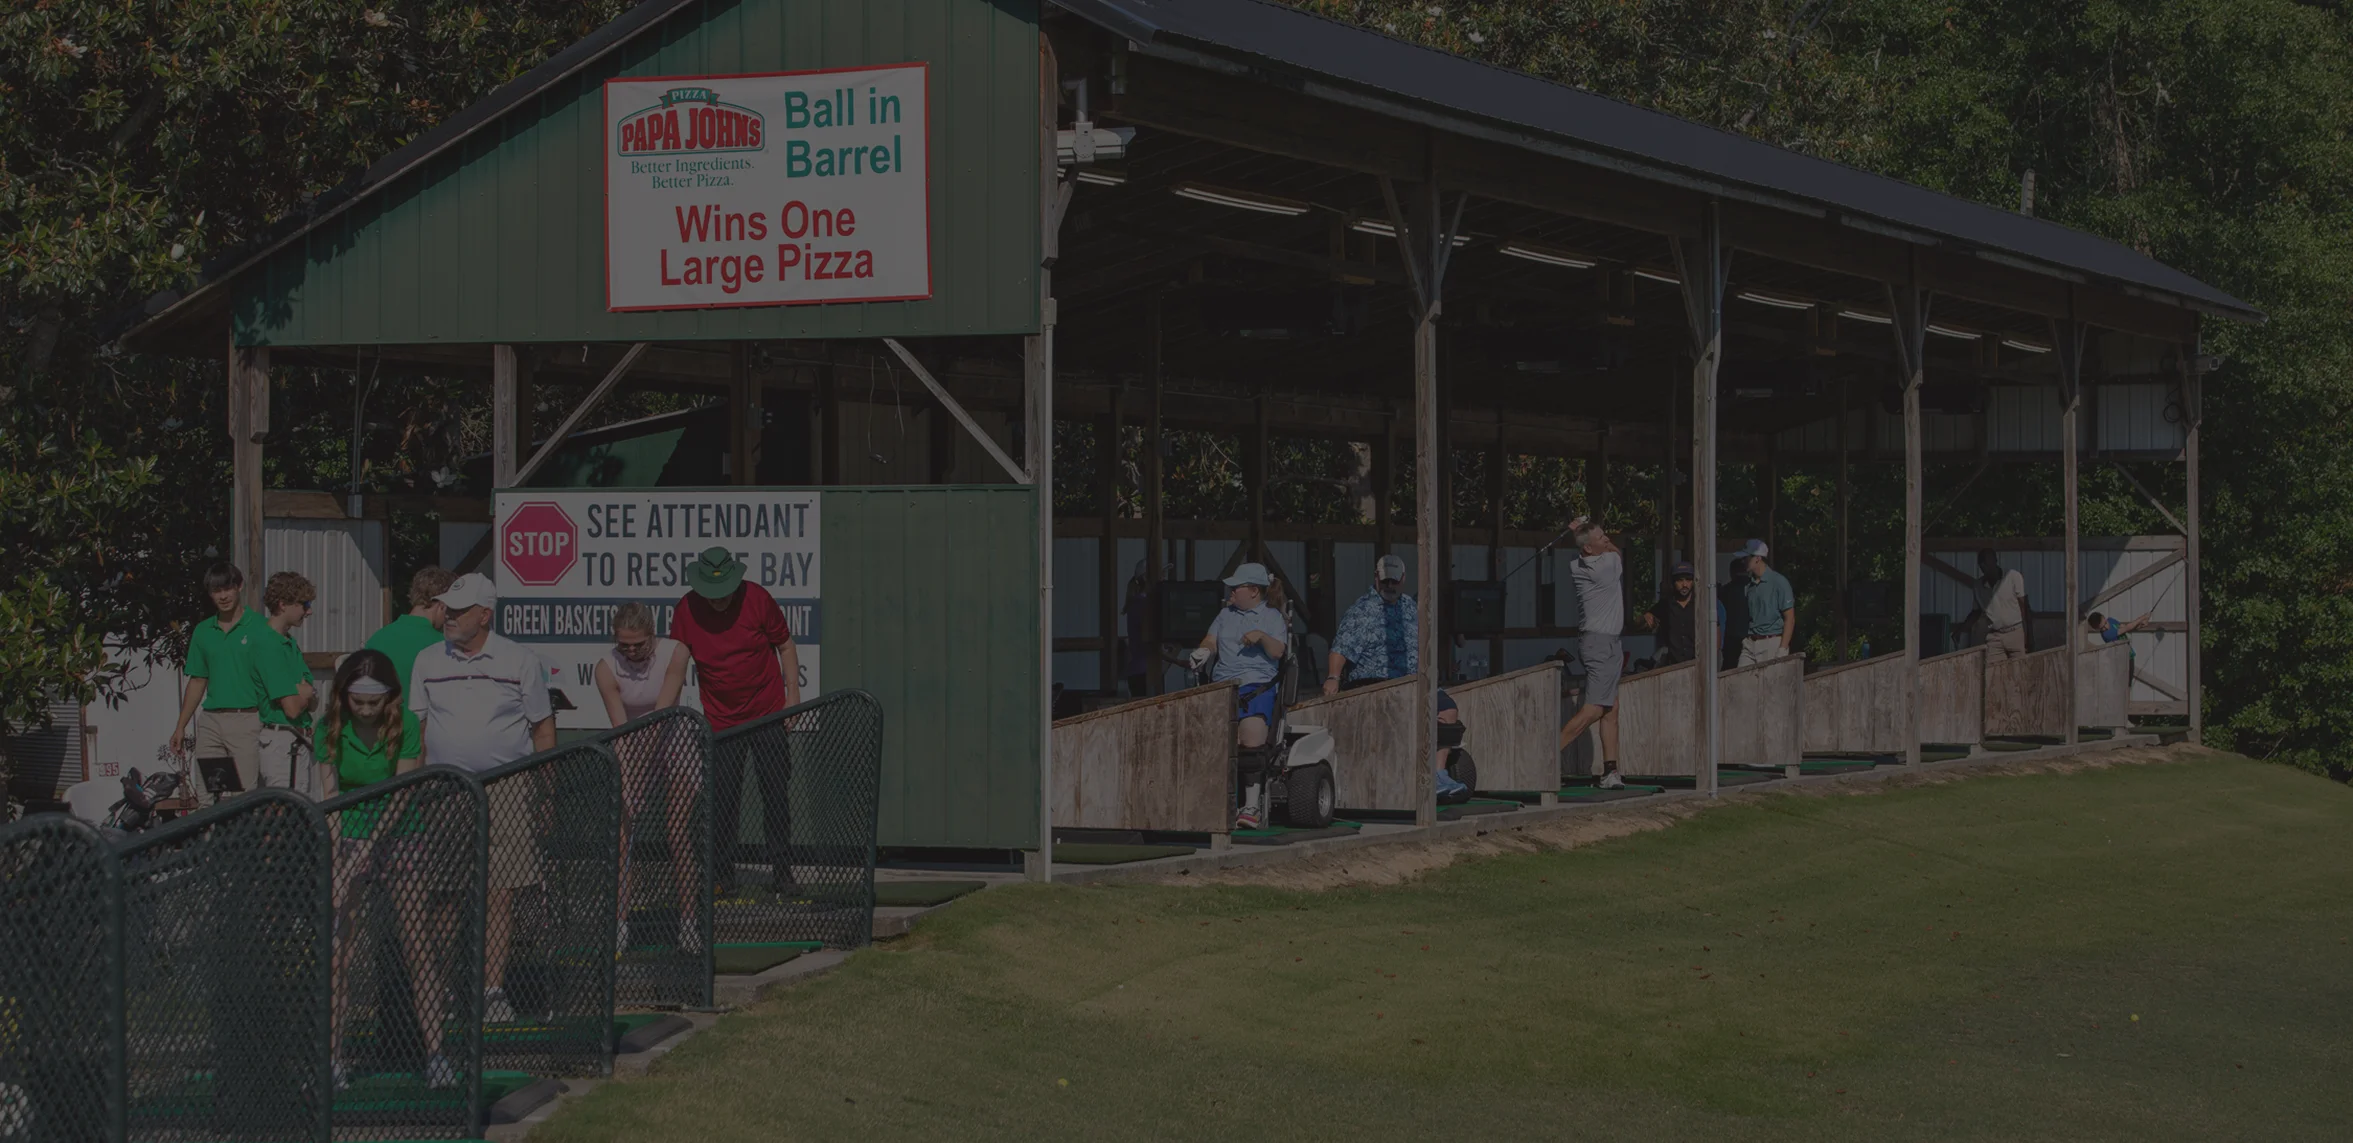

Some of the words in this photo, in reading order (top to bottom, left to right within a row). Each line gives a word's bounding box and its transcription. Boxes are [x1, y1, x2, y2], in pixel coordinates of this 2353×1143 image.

[671, 89, 708, 101] PIZZA
[785, 88, 854, 129] Ball
[870, 87, 901, 125] in
[622, 110, 682, 152] PAPA
[631, 160, 671, 174] Better
[675, 157, 755, 175] Ingredients.
[786, 135, 902, 178] Barrel
[652, 174, 692, 189] Better
[696, 173, 734, 188] Pizza.
[676, 205, 767, 243] Wins
[782, 201, 856, 239] One
[661, 248, 765, 294] Large
[778, 243, 874, 281] Pizza
[587, 504, 637, 538] SEE
[647, 503, 810, 538] ATTENDANT
[510, 532, 570, 557] STOP
[582, 552, 615, 587] TO
[761, 552, 814, 587] BAY
[503, 604, 549, 635] GREEN
